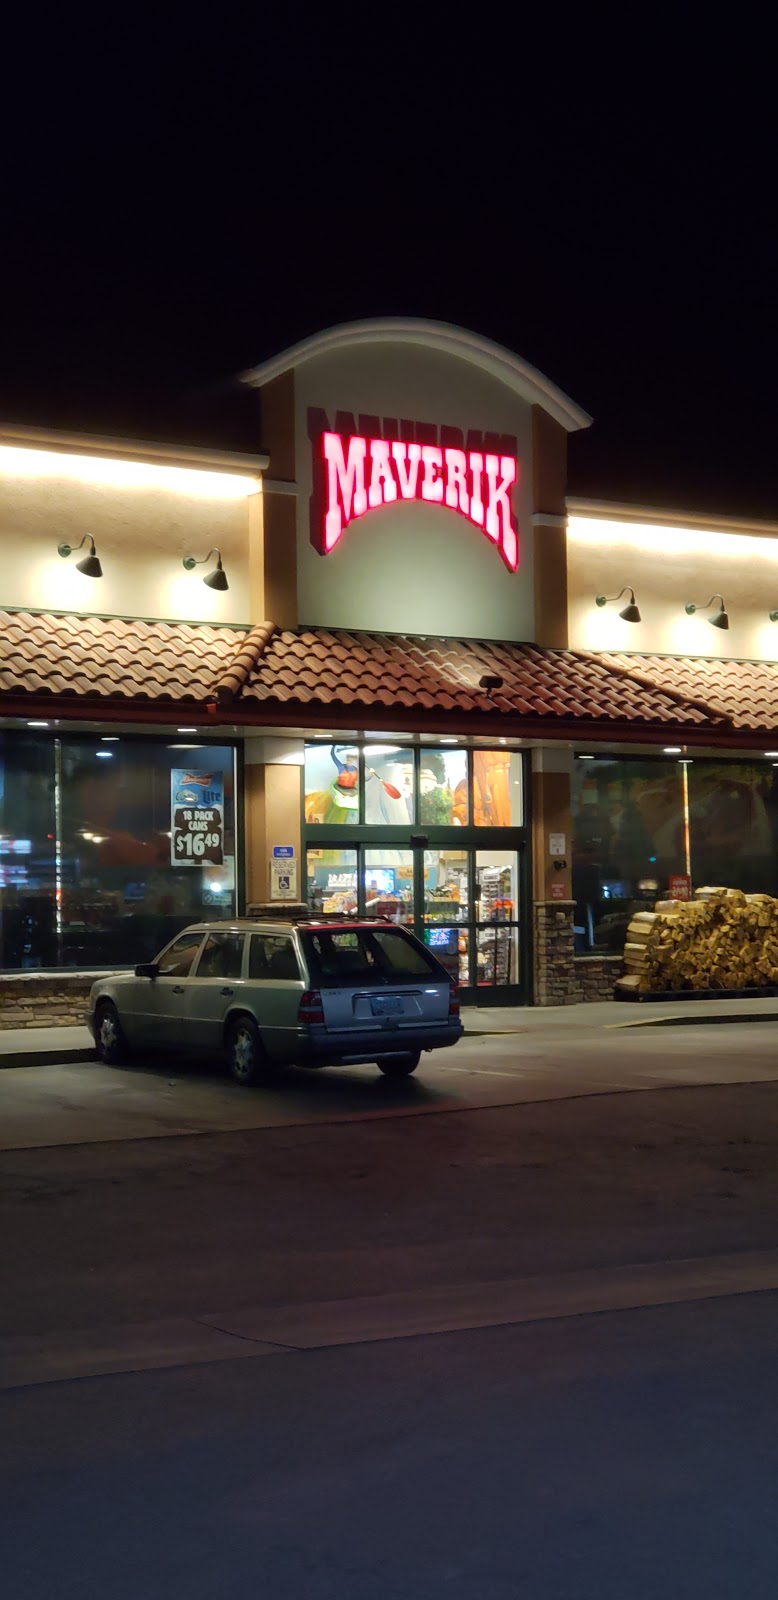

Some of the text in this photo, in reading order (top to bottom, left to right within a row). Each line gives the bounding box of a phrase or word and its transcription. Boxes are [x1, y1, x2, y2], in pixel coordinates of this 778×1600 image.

[322, 431, 520, 573] MAVERIK
[202, 789, 221, 804] Lite
[182, 810, 214, 821] 18 PACK
[188, 821, 208, 831] CANS
